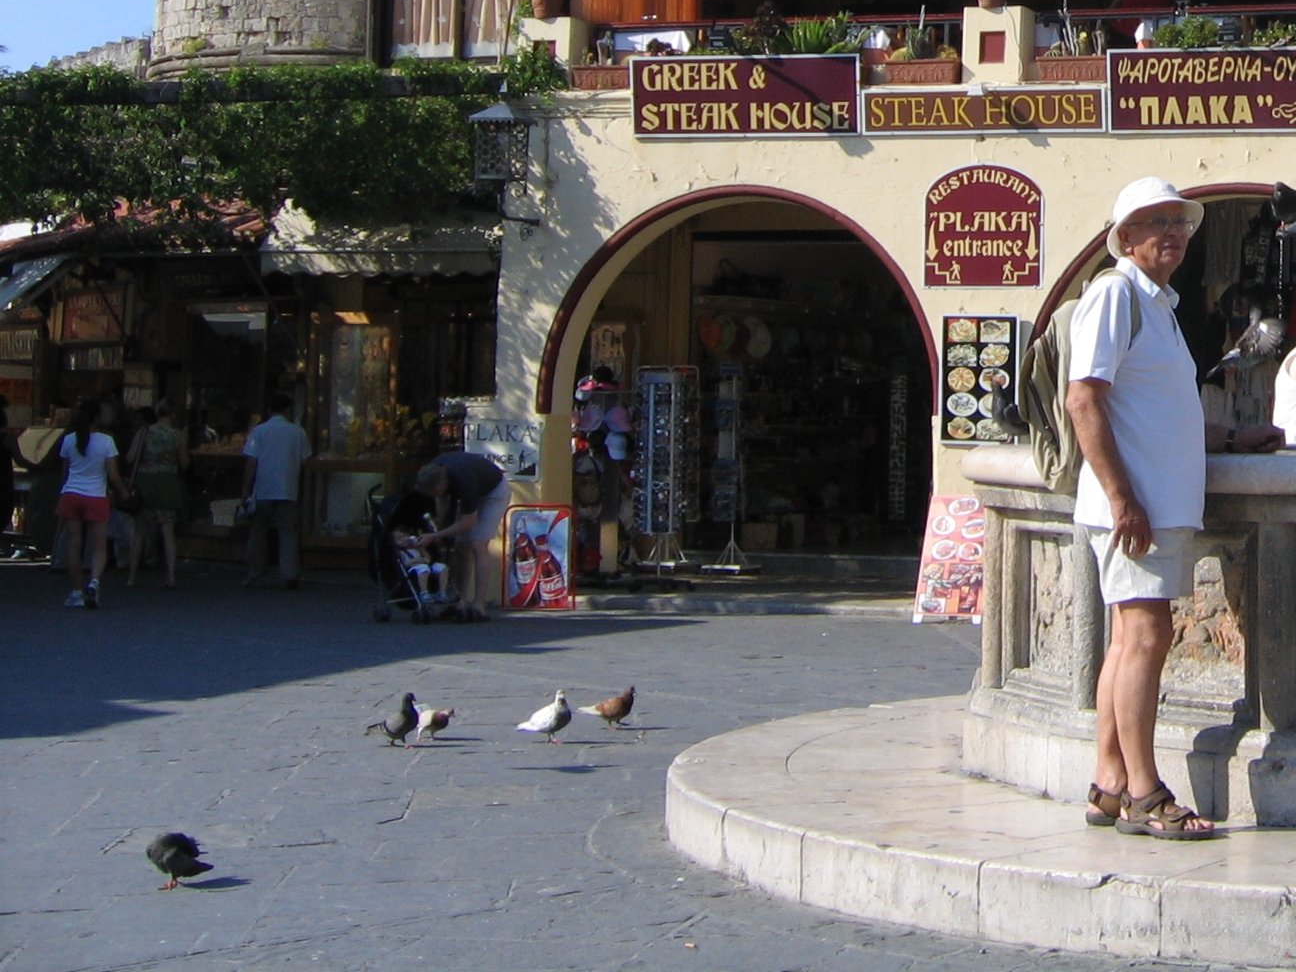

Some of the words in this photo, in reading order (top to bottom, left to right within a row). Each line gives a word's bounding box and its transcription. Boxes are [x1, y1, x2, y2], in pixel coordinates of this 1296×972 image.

[642, 62, 739, 92] GREEK
[748, 63, 767, 90] &
[641, 102, 740, 131] STEAK
[750, 101, 850, 131] HOUSE
[870, 96, 974, 128] STEAK
[983, 94, 1097, 126] HOUSE
[928, 169, 1040, 205] RESTAURANT
[943, 235, 1023, 257] entrance
